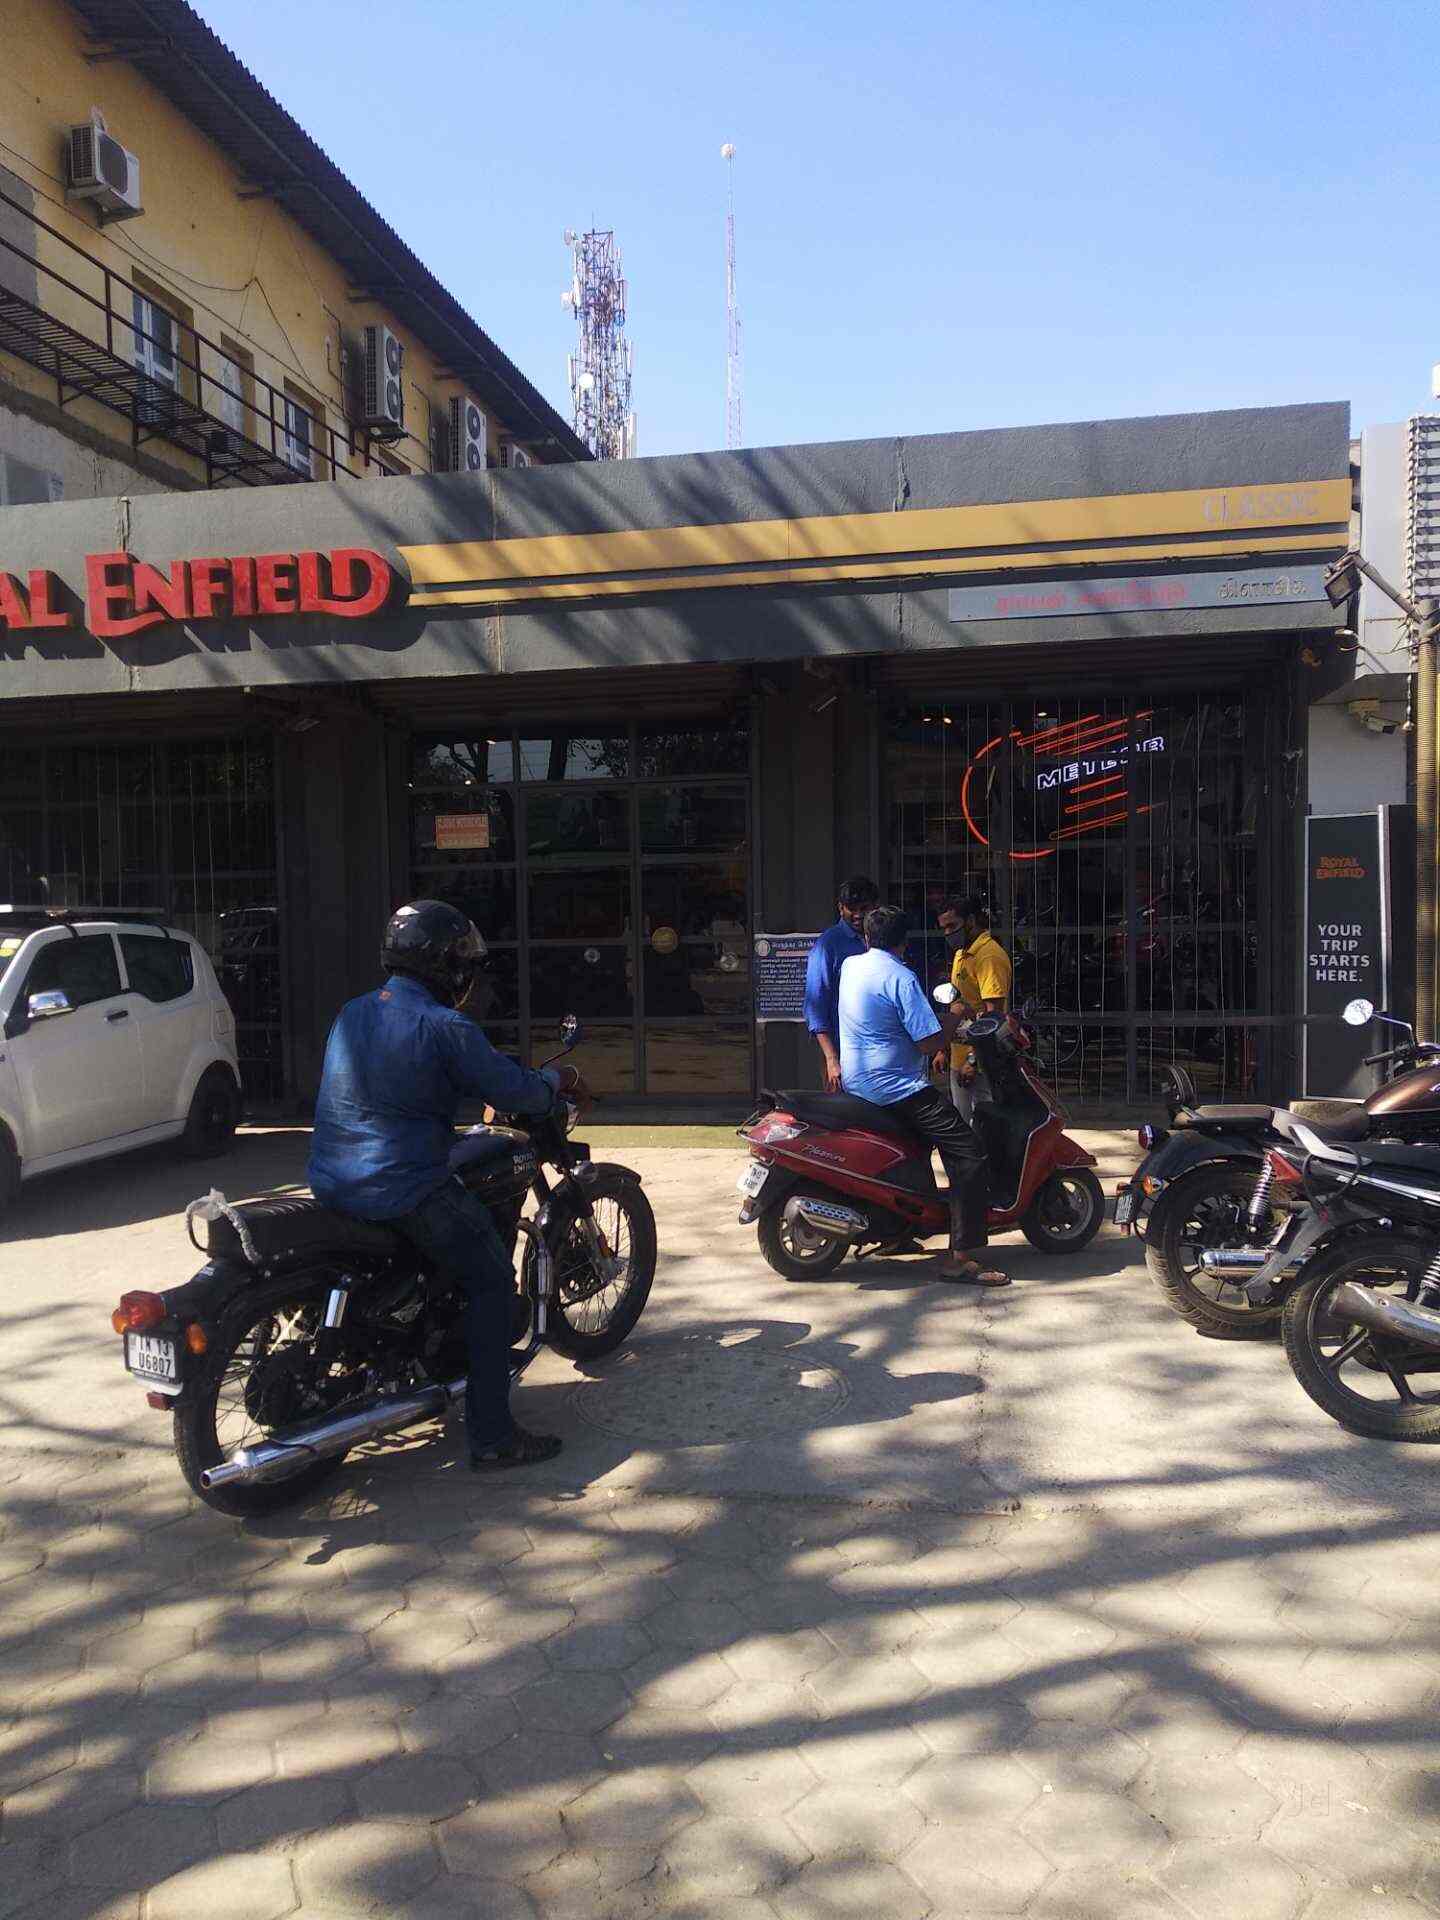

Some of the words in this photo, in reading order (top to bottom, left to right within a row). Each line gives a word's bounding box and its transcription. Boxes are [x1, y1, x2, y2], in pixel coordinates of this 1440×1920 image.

[1203, 488, 1320, 523] CLASSIC
[85, 548, 390, 637] ENFIELD
[1318, 924, 1362, 936] YOUR
[1320, 940, 1358, 951] TRIP
[1309, 955, 1370, 967] STARTS
[1315, 970, 1363, 982] HERE.
